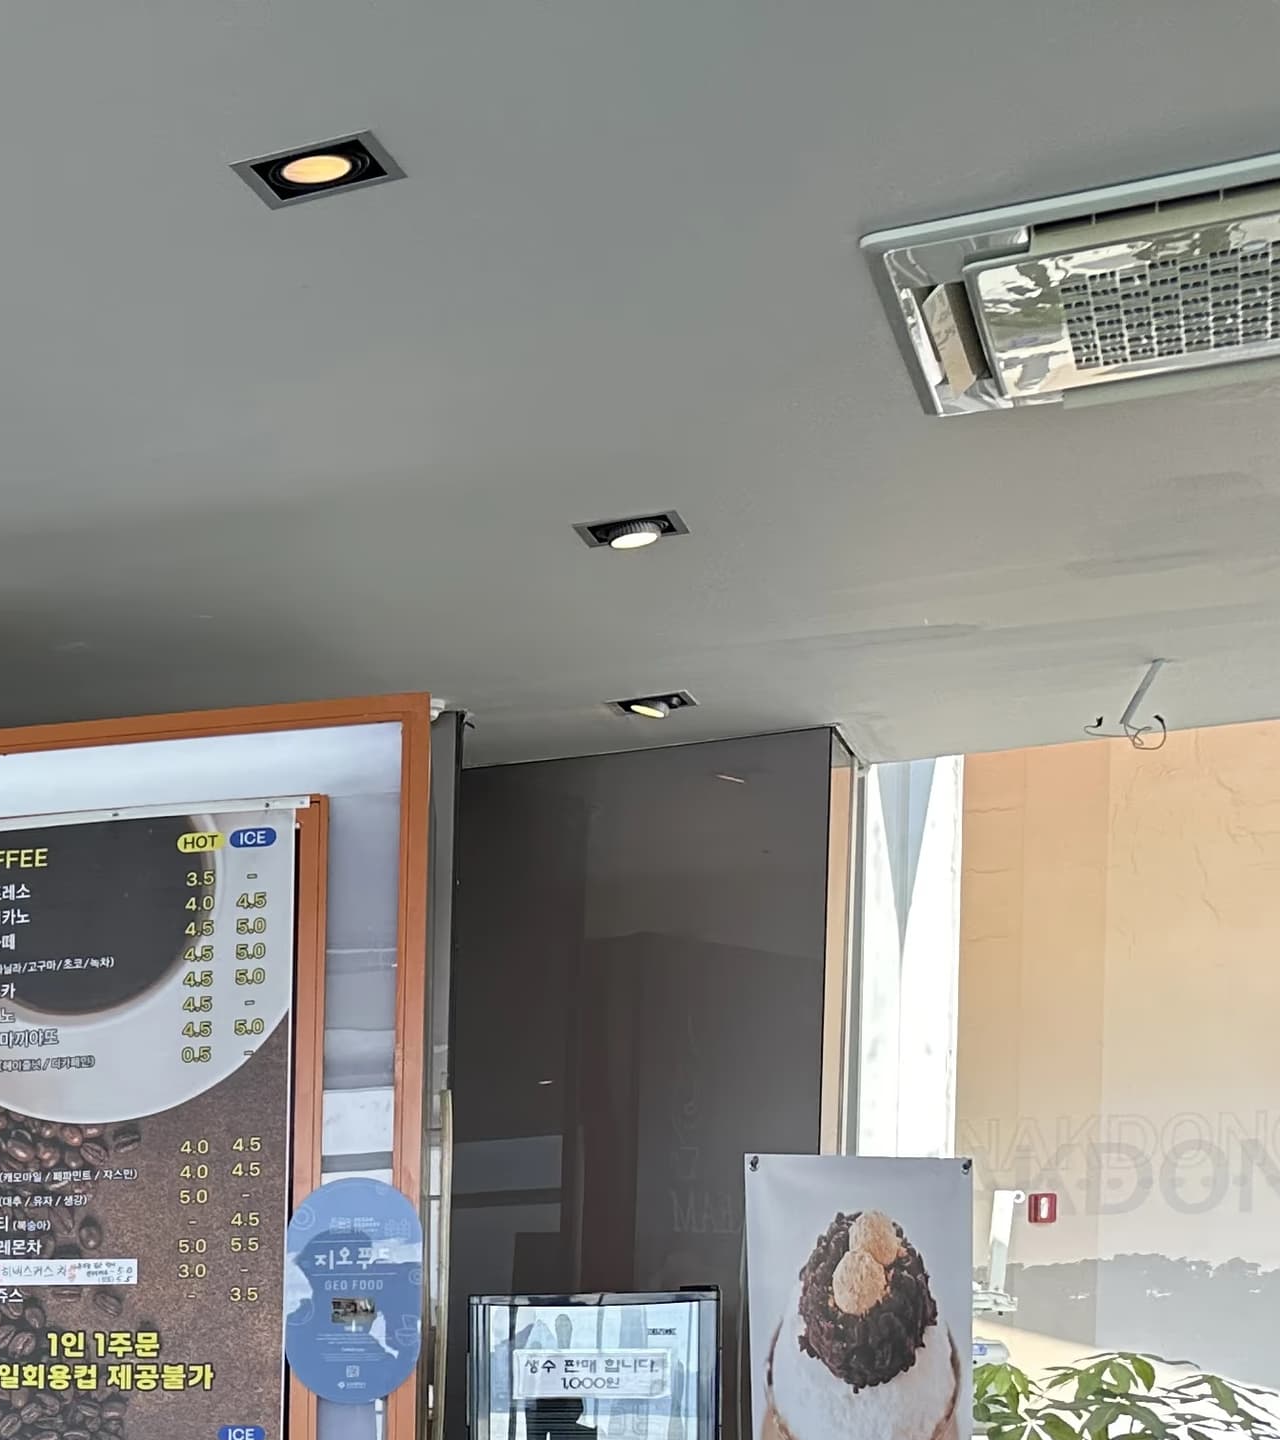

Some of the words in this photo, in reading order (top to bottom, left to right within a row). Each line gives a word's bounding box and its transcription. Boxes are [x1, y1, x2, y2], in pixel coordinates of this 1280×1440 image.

[183, 835, 218, 850] HOT
[239, 831, 267, 846] ICE
[186, 870, 215, 887] 3.5
[185, 895, 215, 911] 4.0
[236, 892, 267, 909] 4.5
[184, 921, 214, 937] 4.5
[236, 918, 267, 934] 5.0
[183, 946, 214, 962] 4.5
[236, 943, 266, 960] 5.0
[183, 971, 213, 987] 4.5
[235, 968, 266, 985] 5.0
[182, 996, 213, 1012] 4.5
[182, 1021, 212, 1037] 4.5
[234, 1018, 265, 1035] 5.0
[182, 1046, 212, 1062] 0.5
[180, 1140, 209, 1155] 4.0
[232, 1138, 262, 1153] 4.5
[180, 1165, 209, 1180] 4.0
[232, 1162, 261, 1177] 4.5
[179, 1189, 208, 1204] 5.0
[231, 1212, 260, 1228] 4.5
[179, 1239, 207, 1253] 5.0
[231, 1237, 259, 1252] 5.5
[314, 1246, 391, 1270] 지오푸드
[178, 1264, 206, 1279] 3.0
[325, 1279, 348, 1291] GEO
[351, 1279, 384, 1291] FOOD
[230, 1288, 258, 1302] 3.5
[47, 1331, 84, 1358] 1인
[94, 1331, 160, 1358] 1주문
[525, 1359, 556, 1374] 생수
[564, 1359, 597, 1374] 판매
[107, 1363, 213, 1390] 제공불가
